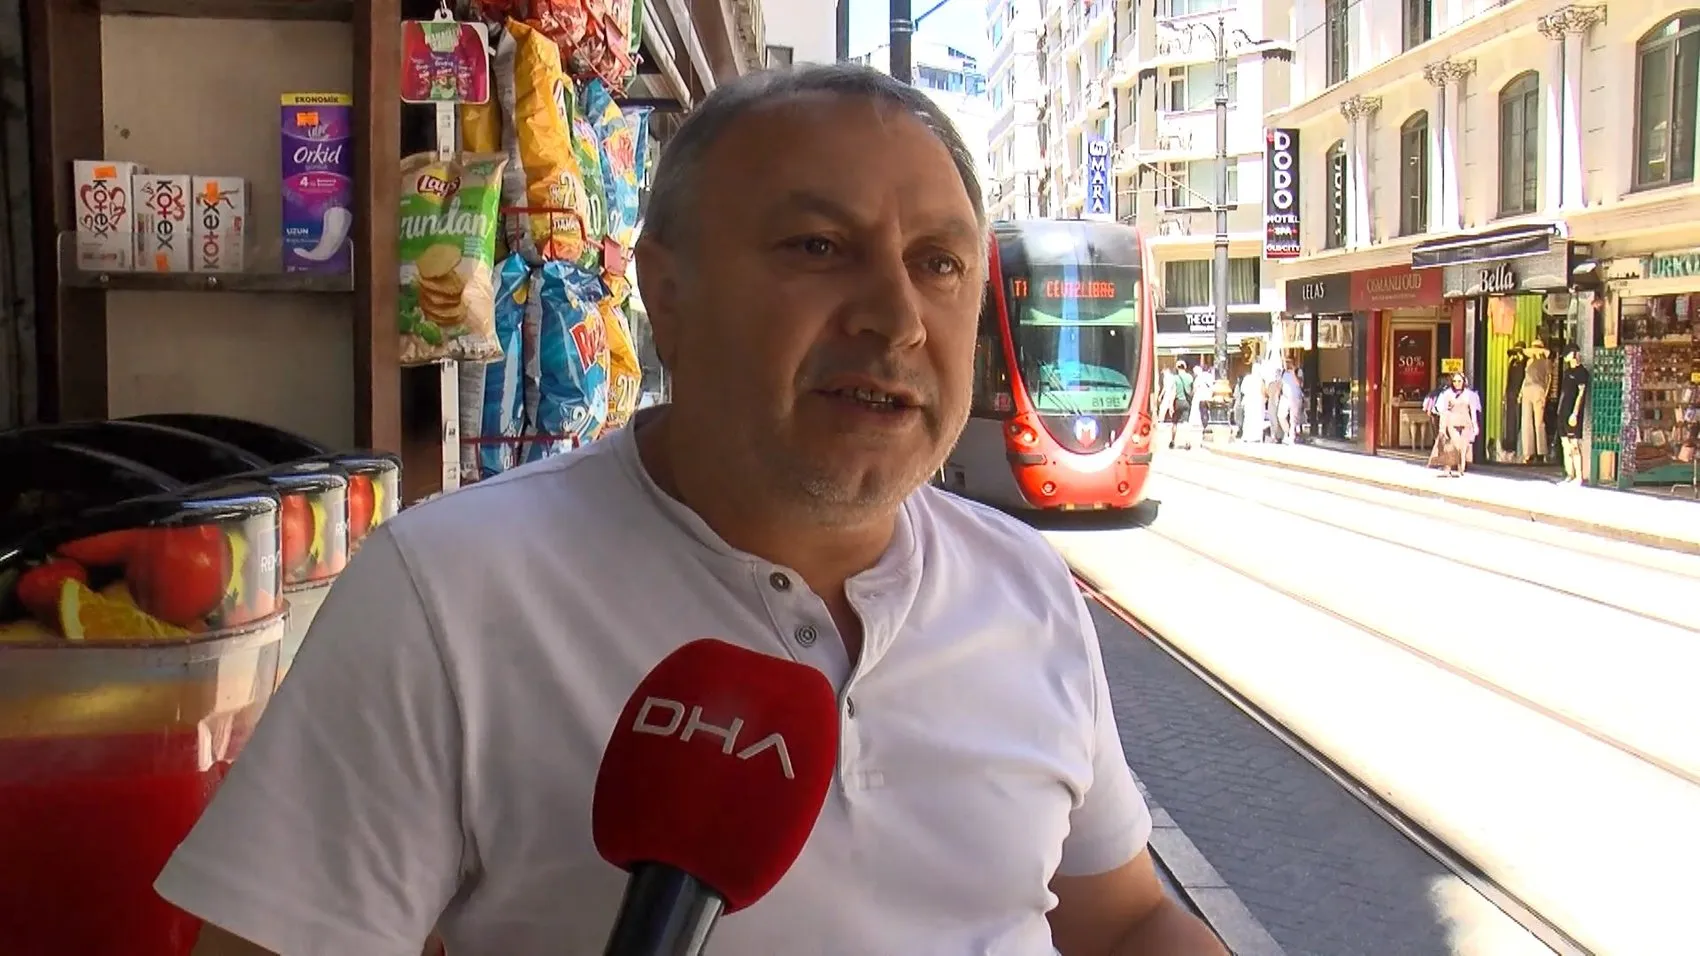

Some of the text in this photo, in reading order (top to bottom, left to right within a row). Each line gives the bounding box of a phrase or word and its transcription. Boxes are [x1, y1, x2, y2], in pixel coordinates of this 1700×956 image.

[293, 143, 342, 164] Orkid
[1273, 131, 1293, 209] DODO
[300, 176, 309, 187] 4
[1267, 215, 1300, 223] HOTEL
[1480, 263, 1514, 292] Bella
[1014, 280, 1027, 297] T1
[1302, 283, 1324, 300] LELAS
[1186, 313, 1200, 325] THE
[1398, 356, 1424, 367] 50%
[632, 696, 795, 779] DHA
